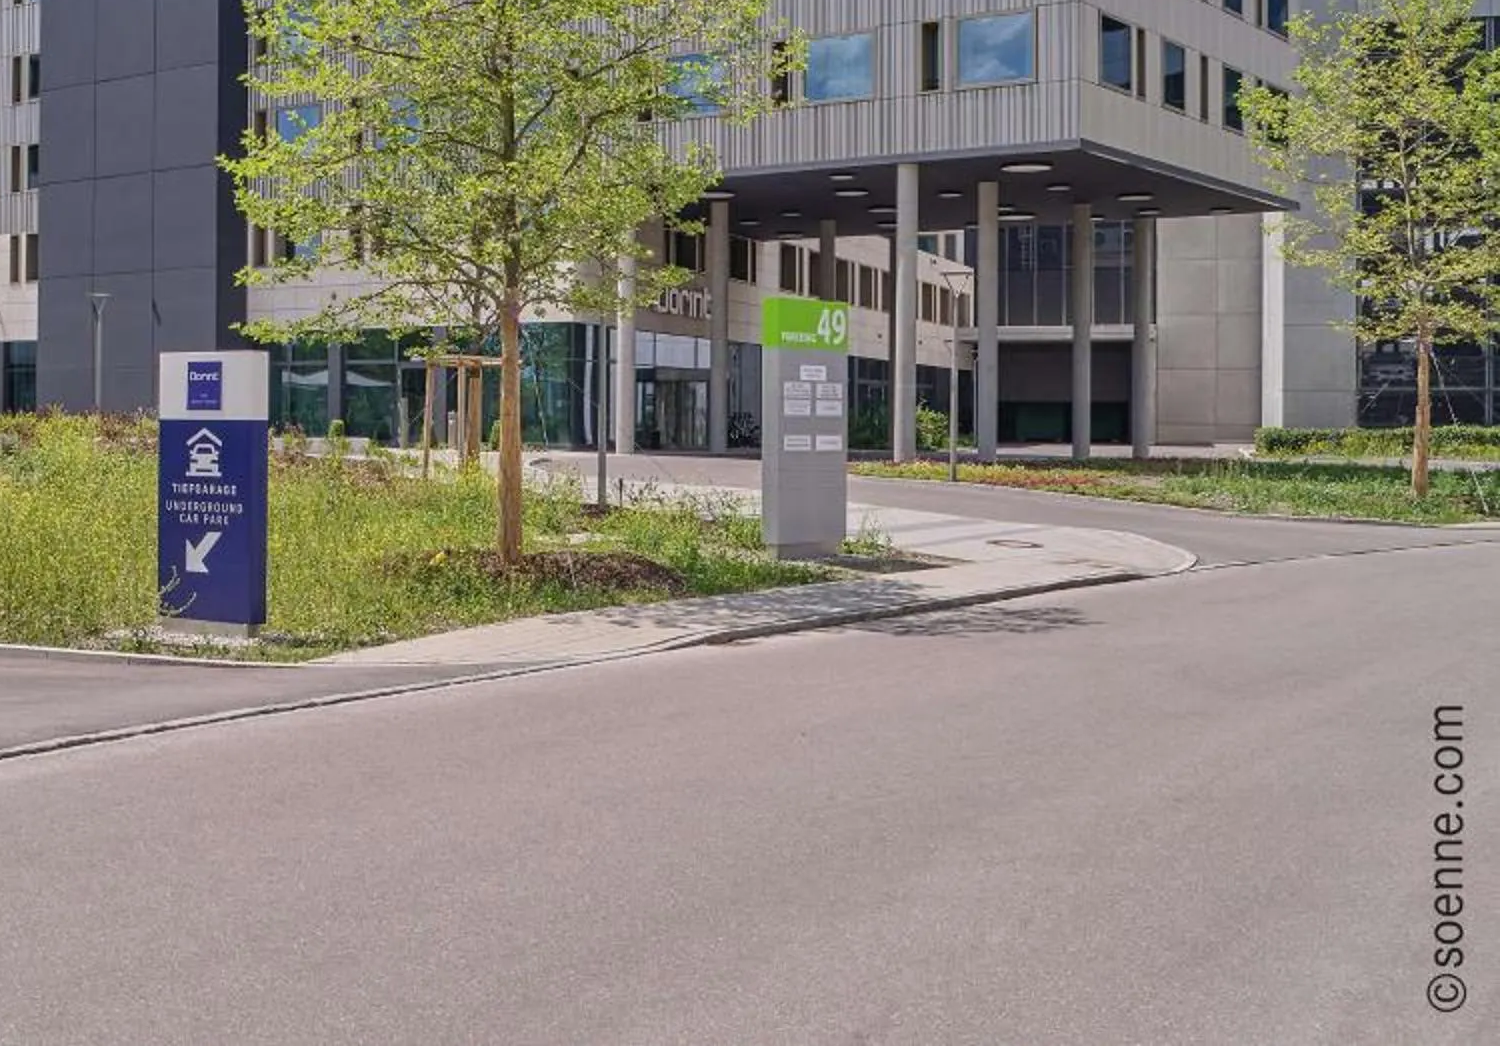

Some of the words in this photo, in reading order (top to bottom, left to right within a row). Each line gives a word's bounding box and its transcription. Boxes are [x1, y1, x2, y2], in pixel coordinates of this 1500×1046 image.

[817, 308, 846, 345] 49
[172, 483, 237, 496] TIEFGARAGE
[165, 500, 243, 514] UNDERGROUND
[180, 514, 199, 524] CAR
[203, 514, 229, 526] PARK
